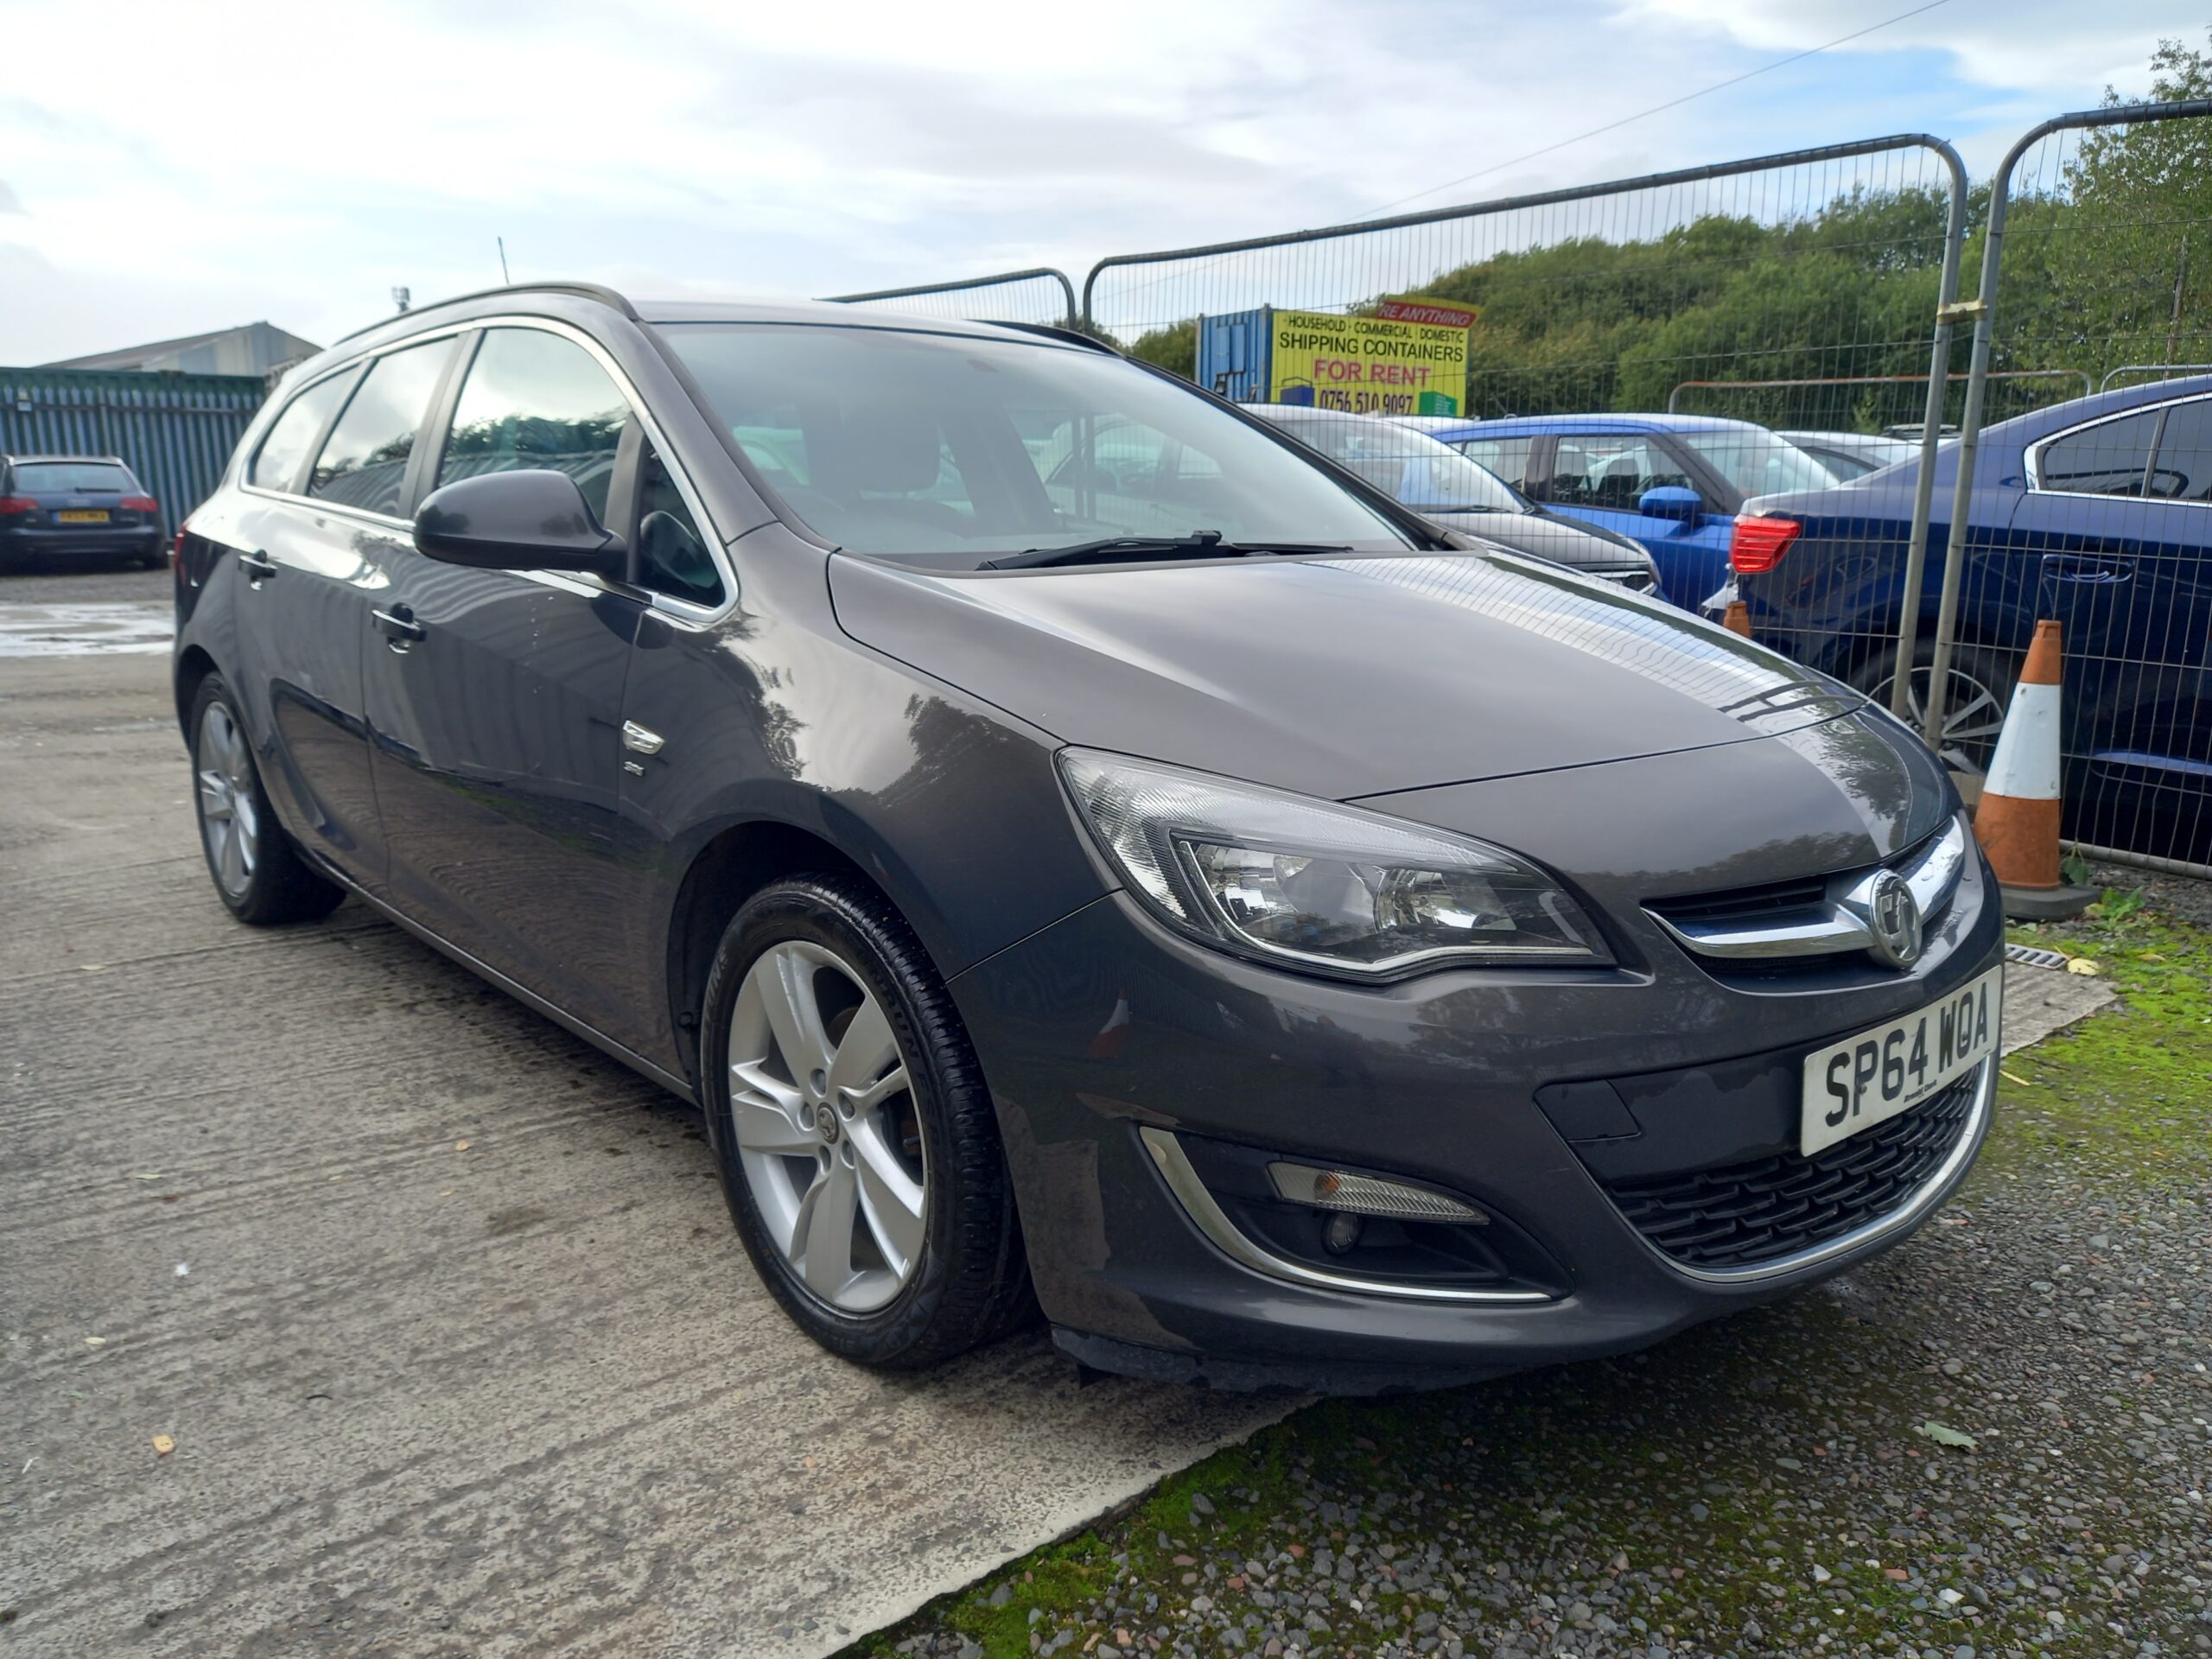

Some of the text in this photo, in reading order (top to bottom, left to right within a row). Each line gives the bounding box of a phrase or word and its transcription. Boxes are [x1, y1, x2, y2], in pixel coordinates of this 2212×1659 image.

[1289, 315, 1464, 343] HOUSEHOLD COMMERCIAL DOMESTIC
[1399, 308, 1470, 326] ANYTHING
[1280, 332, 1463, 362] SHIPPING CONTAINERS
[1314, 359, 1431, 388] FOR RENT
[1319, 389, 1351, 413] 0756
[1825, 1016, 1928, 1127] SP64
